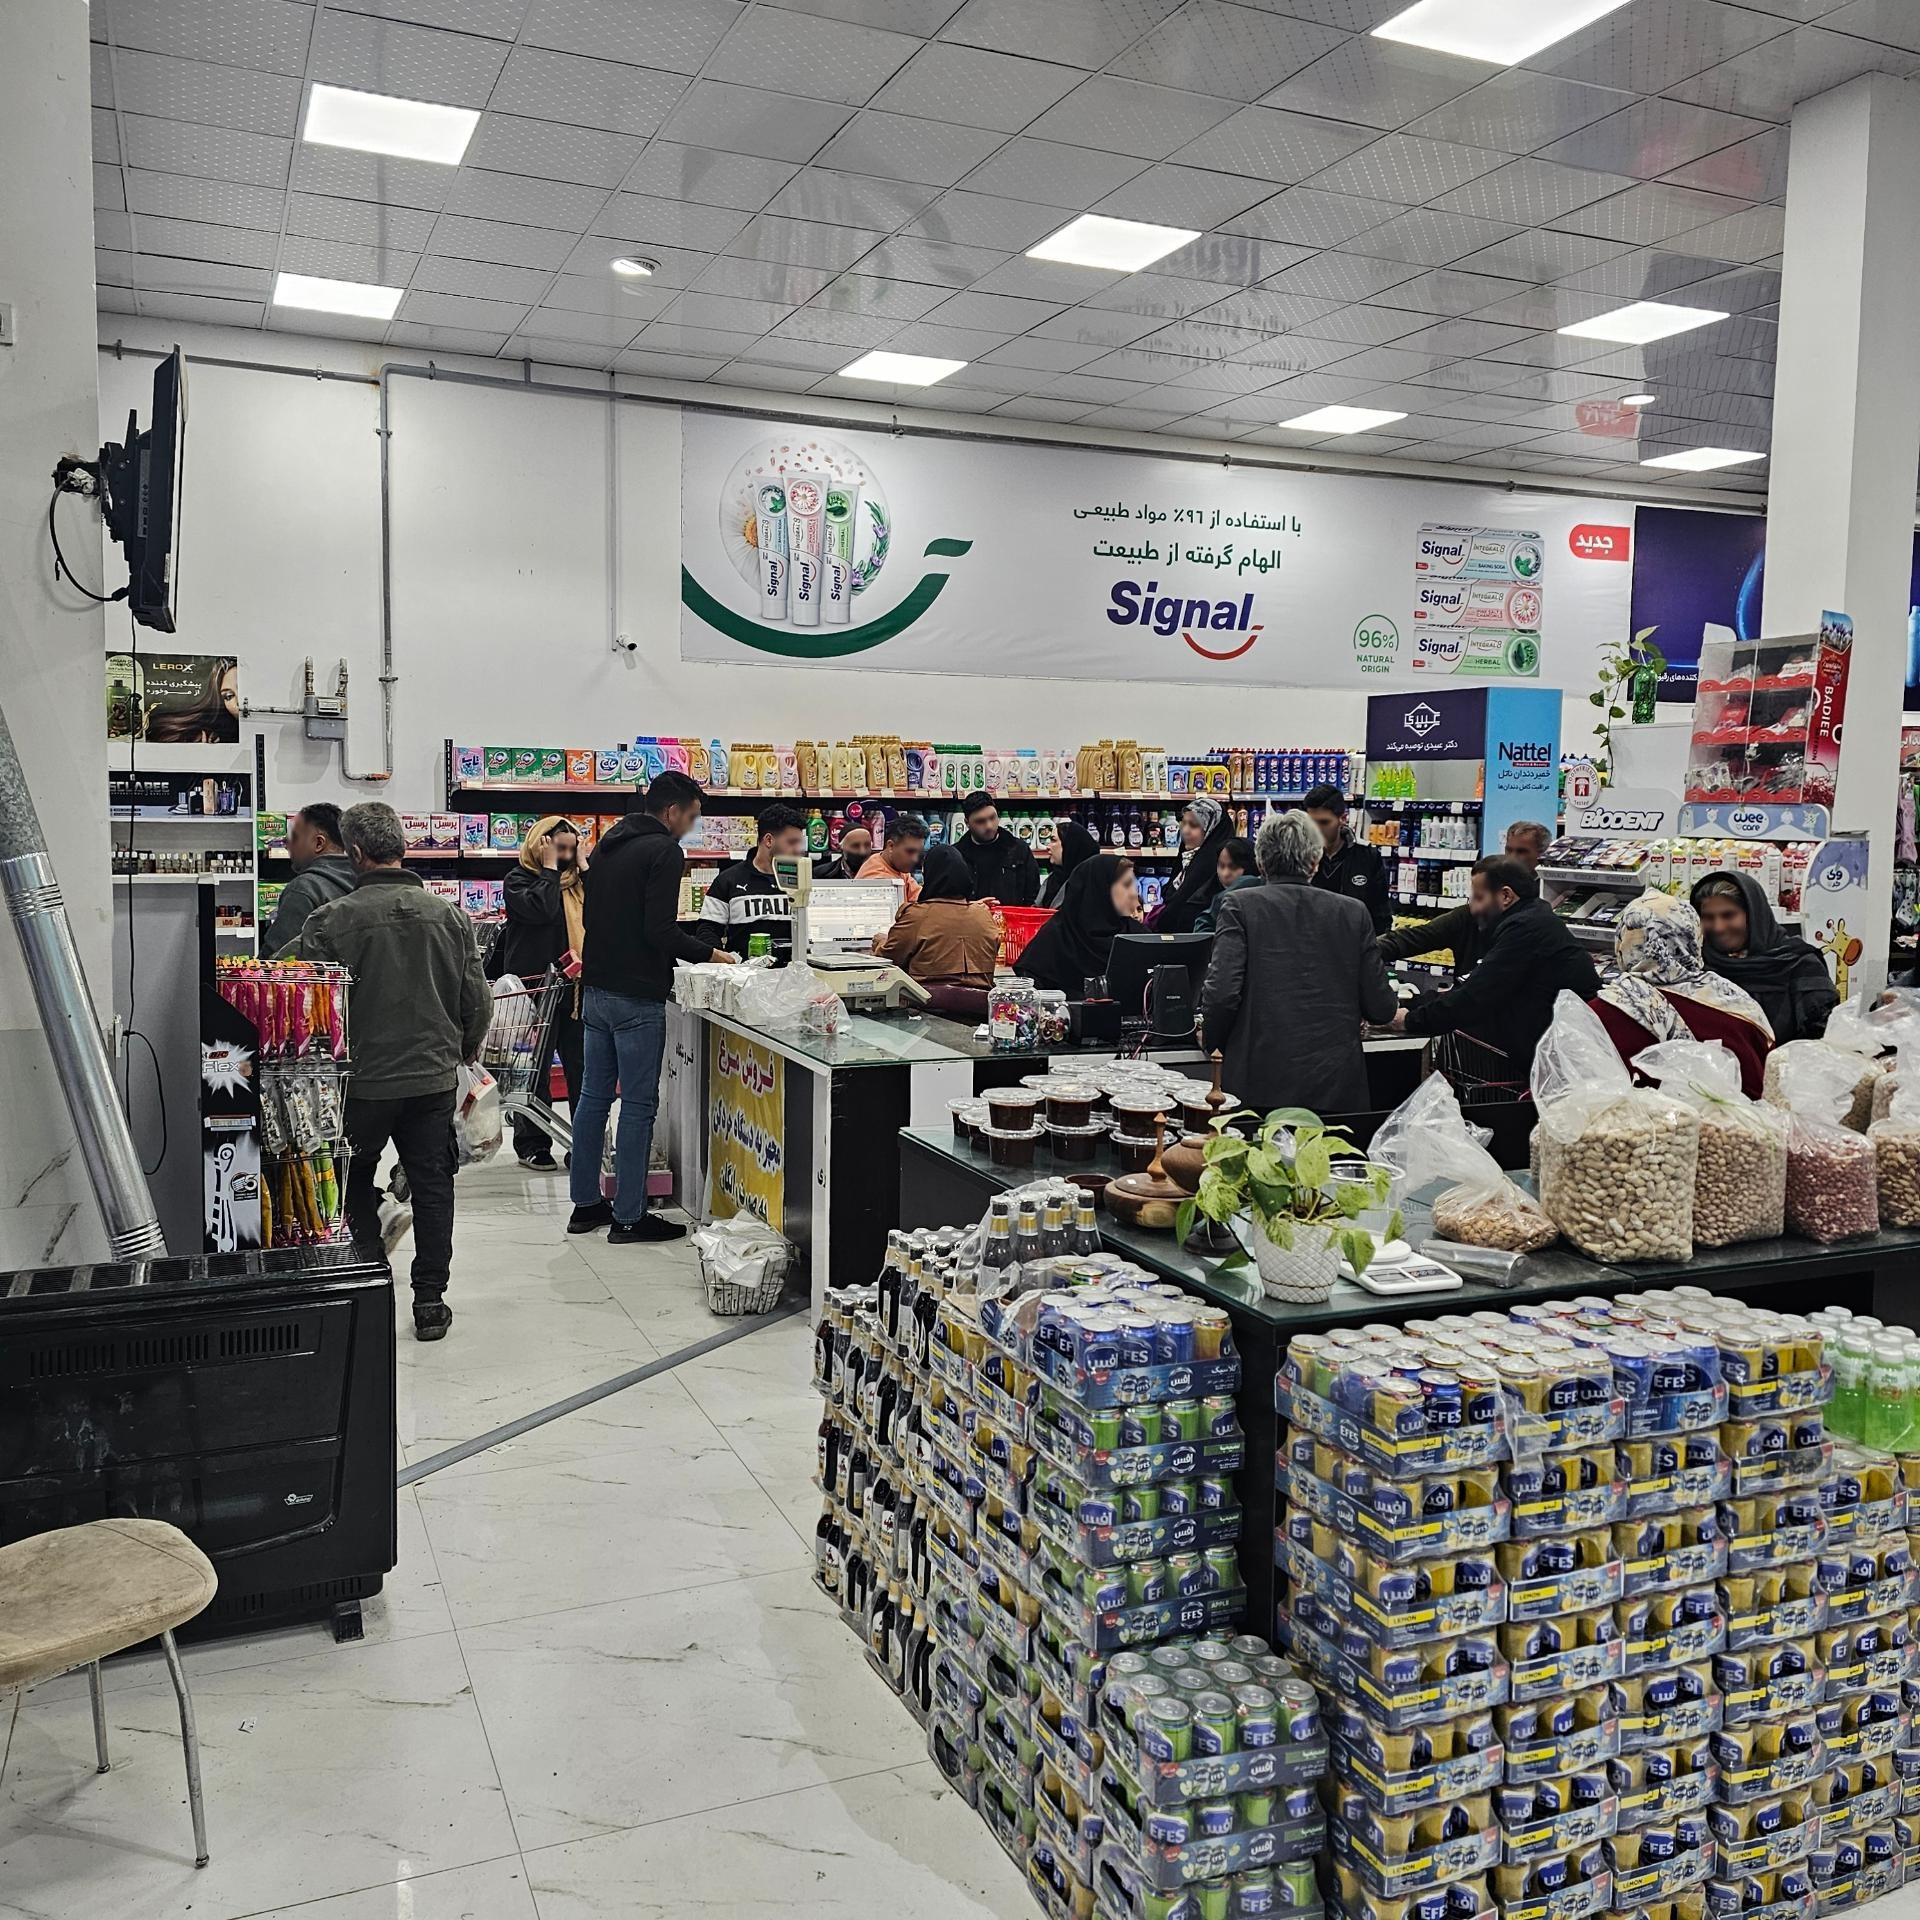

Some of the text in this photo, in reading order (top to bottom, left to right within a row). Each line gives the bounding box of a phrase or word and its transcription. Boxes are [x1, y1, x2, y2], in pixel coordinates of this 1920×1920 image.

[1073, 502, 1129, 522] طبیعی
[1135, 504, 1167, 524] مواد
[1210, 510, 1220, 529] از
[1225, 512, 1286, 531] استفاده
[1292, 516, 1302, 537] با
[1422, 540, 1463, 557] Signal
[1576, 532, 1614, 554] جدید
[1093, 540, 1281, 576] الهام گرفته از طبیعت
[768, 560, 780, 597] Signal
[799, 562, 812, 601] Signal
[831, 564, 842, 601] Signal
[1420, 589, 1461, 606] Signal
[1106, 580, 1255, 636] Signal
[1359, 630, 1395, 649] 96%
[1419, 638, 1459, 655] Signal
[1356, 655, 1395, 664] NATURAL
[153, 663, 196, 672] LEROX
[1361, 665, 1390, 673] ORIGIN
[169, 681, 202, 690] پیشگیری
[1820, 686, 1834, 737] BADIEE
[1404, 742, 1423, 752] توصیه
[1424, 742, 1442, 751] عبیدی
[1443, 740, 1458, 750] دکتر
[1498, 742, 1551, 761] Nattel
[462, 755, 479, 767] تاپ
[1498, 769, 1512, 780] ناتل
[1733, 811, 1764, 824] wee
[404, 819, 428, 830] پرسیل
[434, 820, 457, 830] پرسیل
[466, 822, 484, 834] تاپ
[493, 826, 515, 835] SEPID
[1742, 822, 1761, 832] care
[434, 886, 457, 896] پرسیل
[466, 890, 483, 902] تاپ
[744, 898, 796, 917] ITALI
[209, 1051, 229, 1059] BIC
[719, 1031, 740, 1076] مرغ
[203, 1061, 240, 1073] Flex
[741, 1047, 774, 1094] فروش
[1211, 1365, 1238, 1375] کلاسیک
[1653, 1375, 1686, 1388] EFES
[1428, 1409, 1462, 1424] EFES
[1632, 1408, 1658, 1417] ORIGINAL
[1340, 1426, 1359, 1444] EFES
[1402, 1527, 1425, 1537] LEMON
[1540, 1553, 1574, 1569] EFES
[1519, 1591, 1541, 1600] LEMON
[1210, 1600, 1230, 1608] APPLE
[1181, 1610, 1204, 1621] EFES
[1393, 1614, 1417, 1624] LEMON
[1521, 1671, 1542, 1681] LEMON
[1400, 1695, 1423, 1704] LEMON
[1243, 1730, 1276, 1746] EFES
[1517, 1752, 1539, 1761] LEMON
[1395, 1782, 1418, 1792] LEMON
[1908, 1787, 1920, 1795] LEMO
[1150, 1826, 1186, 1843] EFES
[1515, 1834, 1536, 1844] LEMON
[1733, 1851, 1752, 1860] LEMON
[1907, 1856, 1920, 1865] LEMO
[1393, 1864, 1416, 1874] LEMON
[1623, 1878, 1643, 1889] LEMON
[1822, 1887, 1839, 1899] LEMON
[1241, 1897, 1272, 1913] EFES
